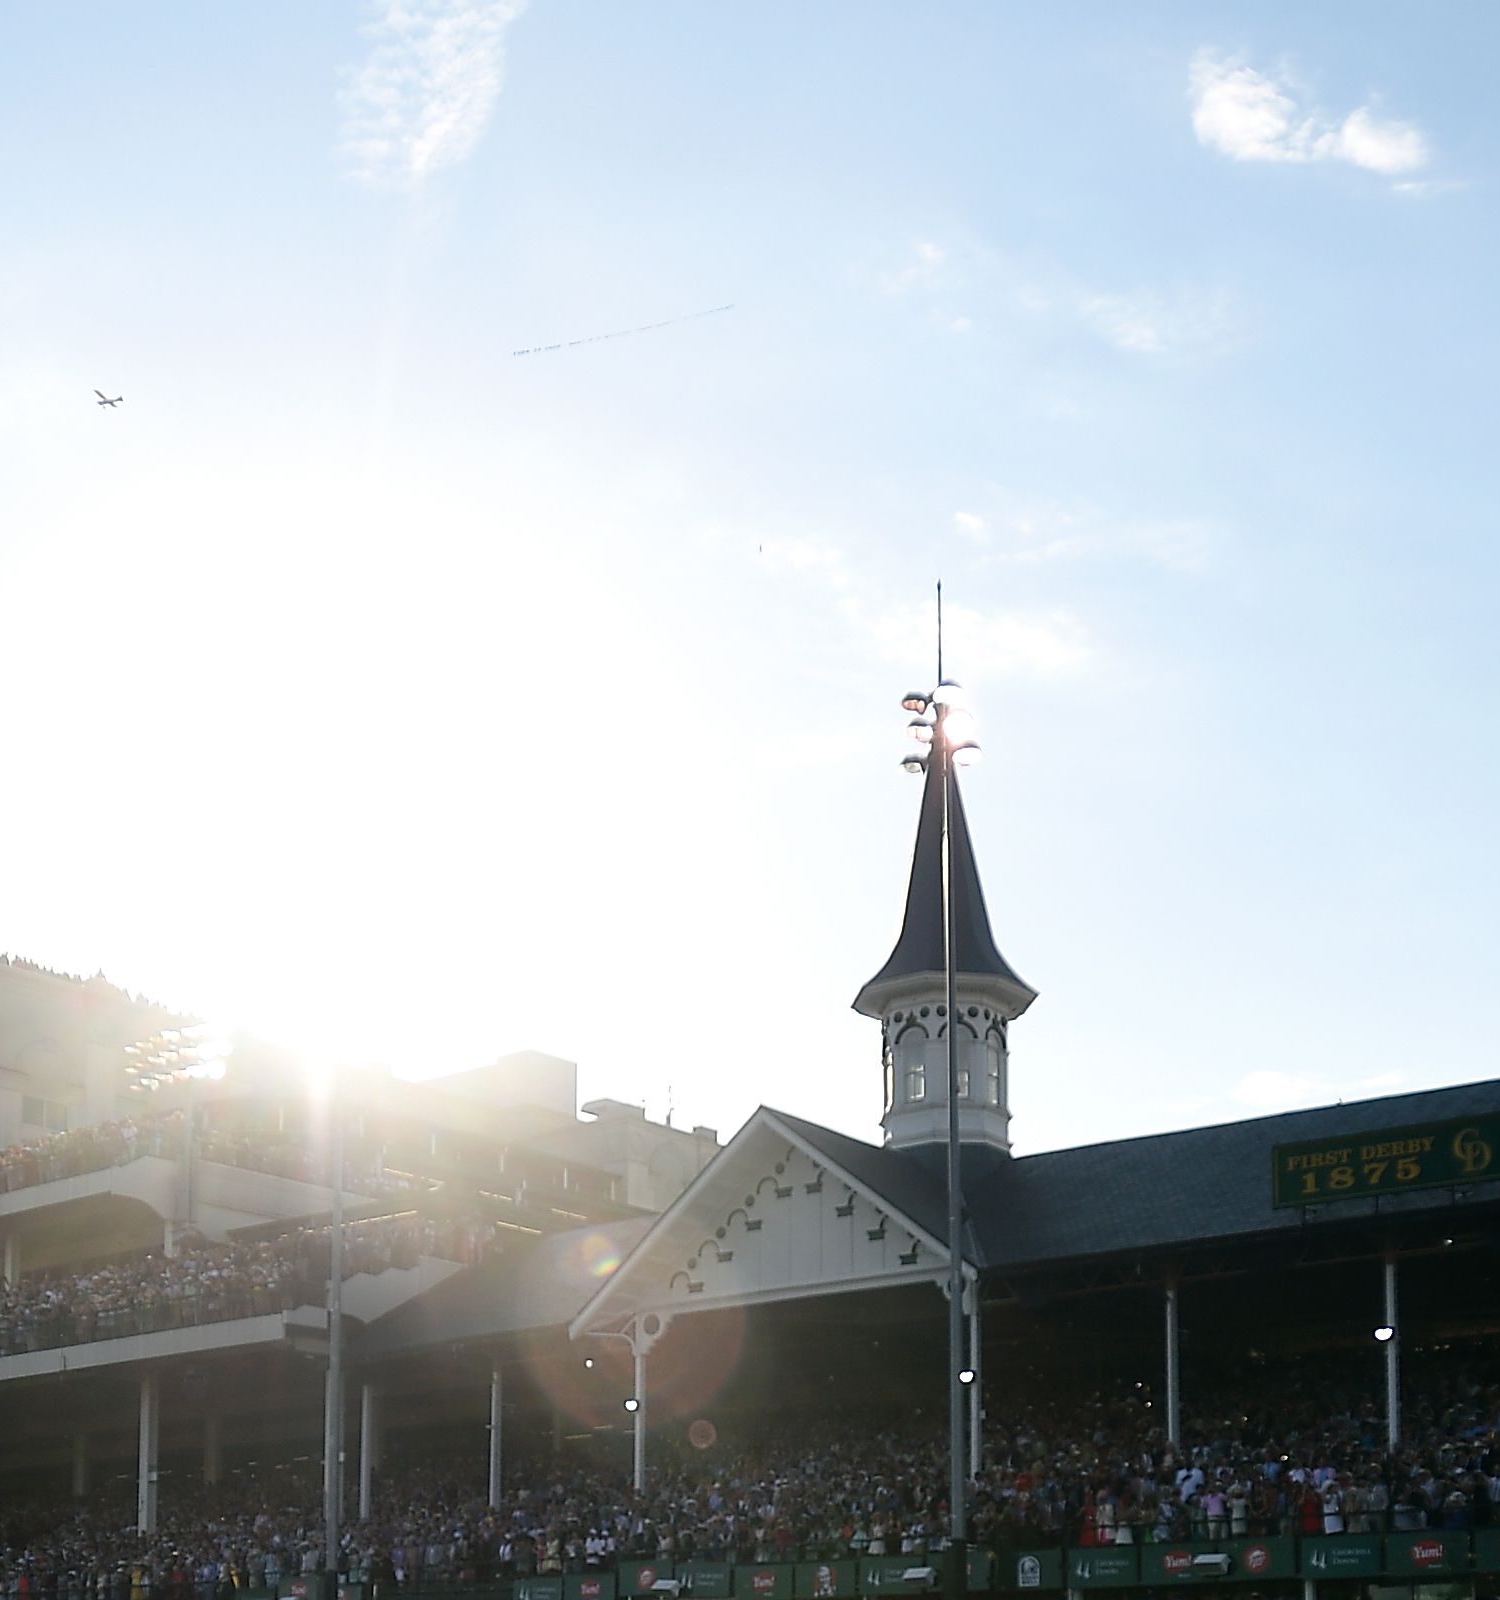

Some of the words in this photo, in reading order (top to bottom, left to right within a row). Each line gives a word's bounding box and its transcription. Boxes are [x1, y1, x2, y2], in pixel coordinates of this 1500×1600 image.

[1286, 1147, 1353, 1171] FIRST
[1361, 1136, 1435, 1160] DERBY
[1301, 1158, 1422, 1194] 1875
[1413, 1544, 1444, 1560] Yum!
